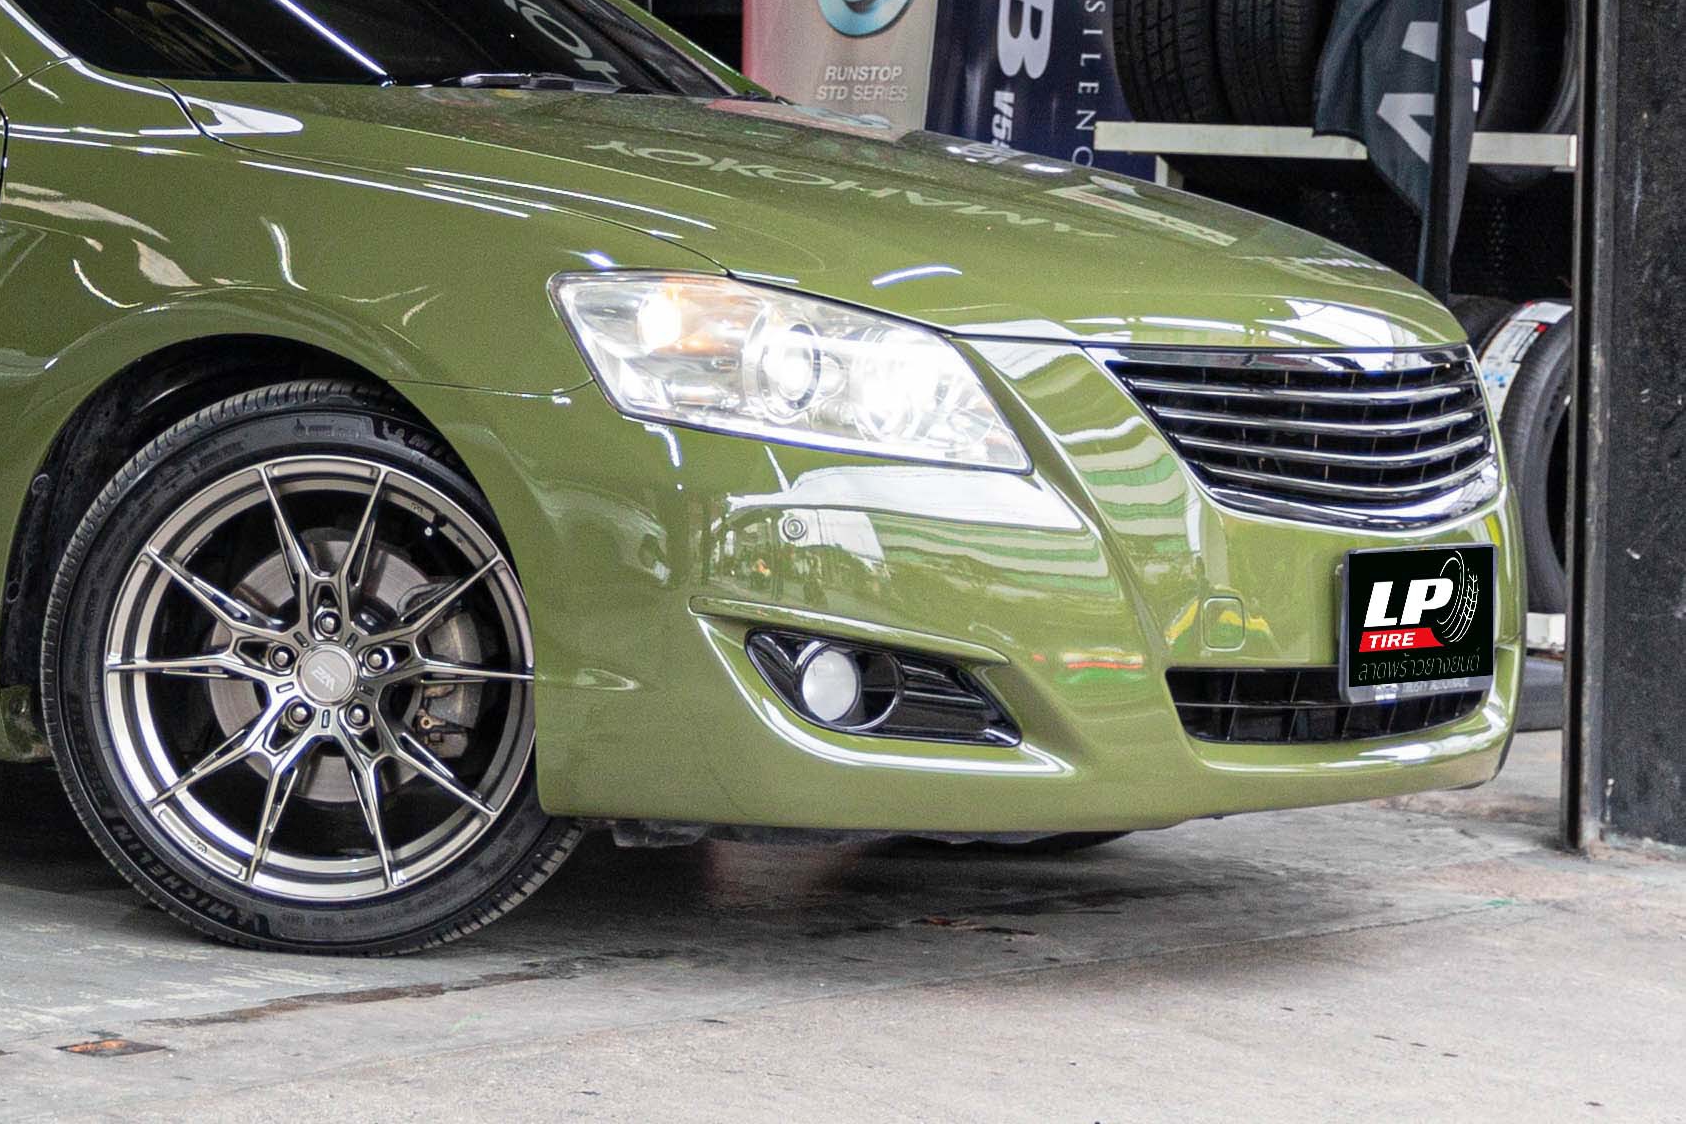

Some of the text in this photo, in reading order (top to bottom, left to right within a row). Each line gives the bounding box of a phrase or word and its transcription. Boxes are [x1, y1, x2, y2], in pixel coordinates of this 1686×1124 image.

[824, 66, 903, 83] RUNSTOP
[817, 84, 909, 103] STD SERIES
